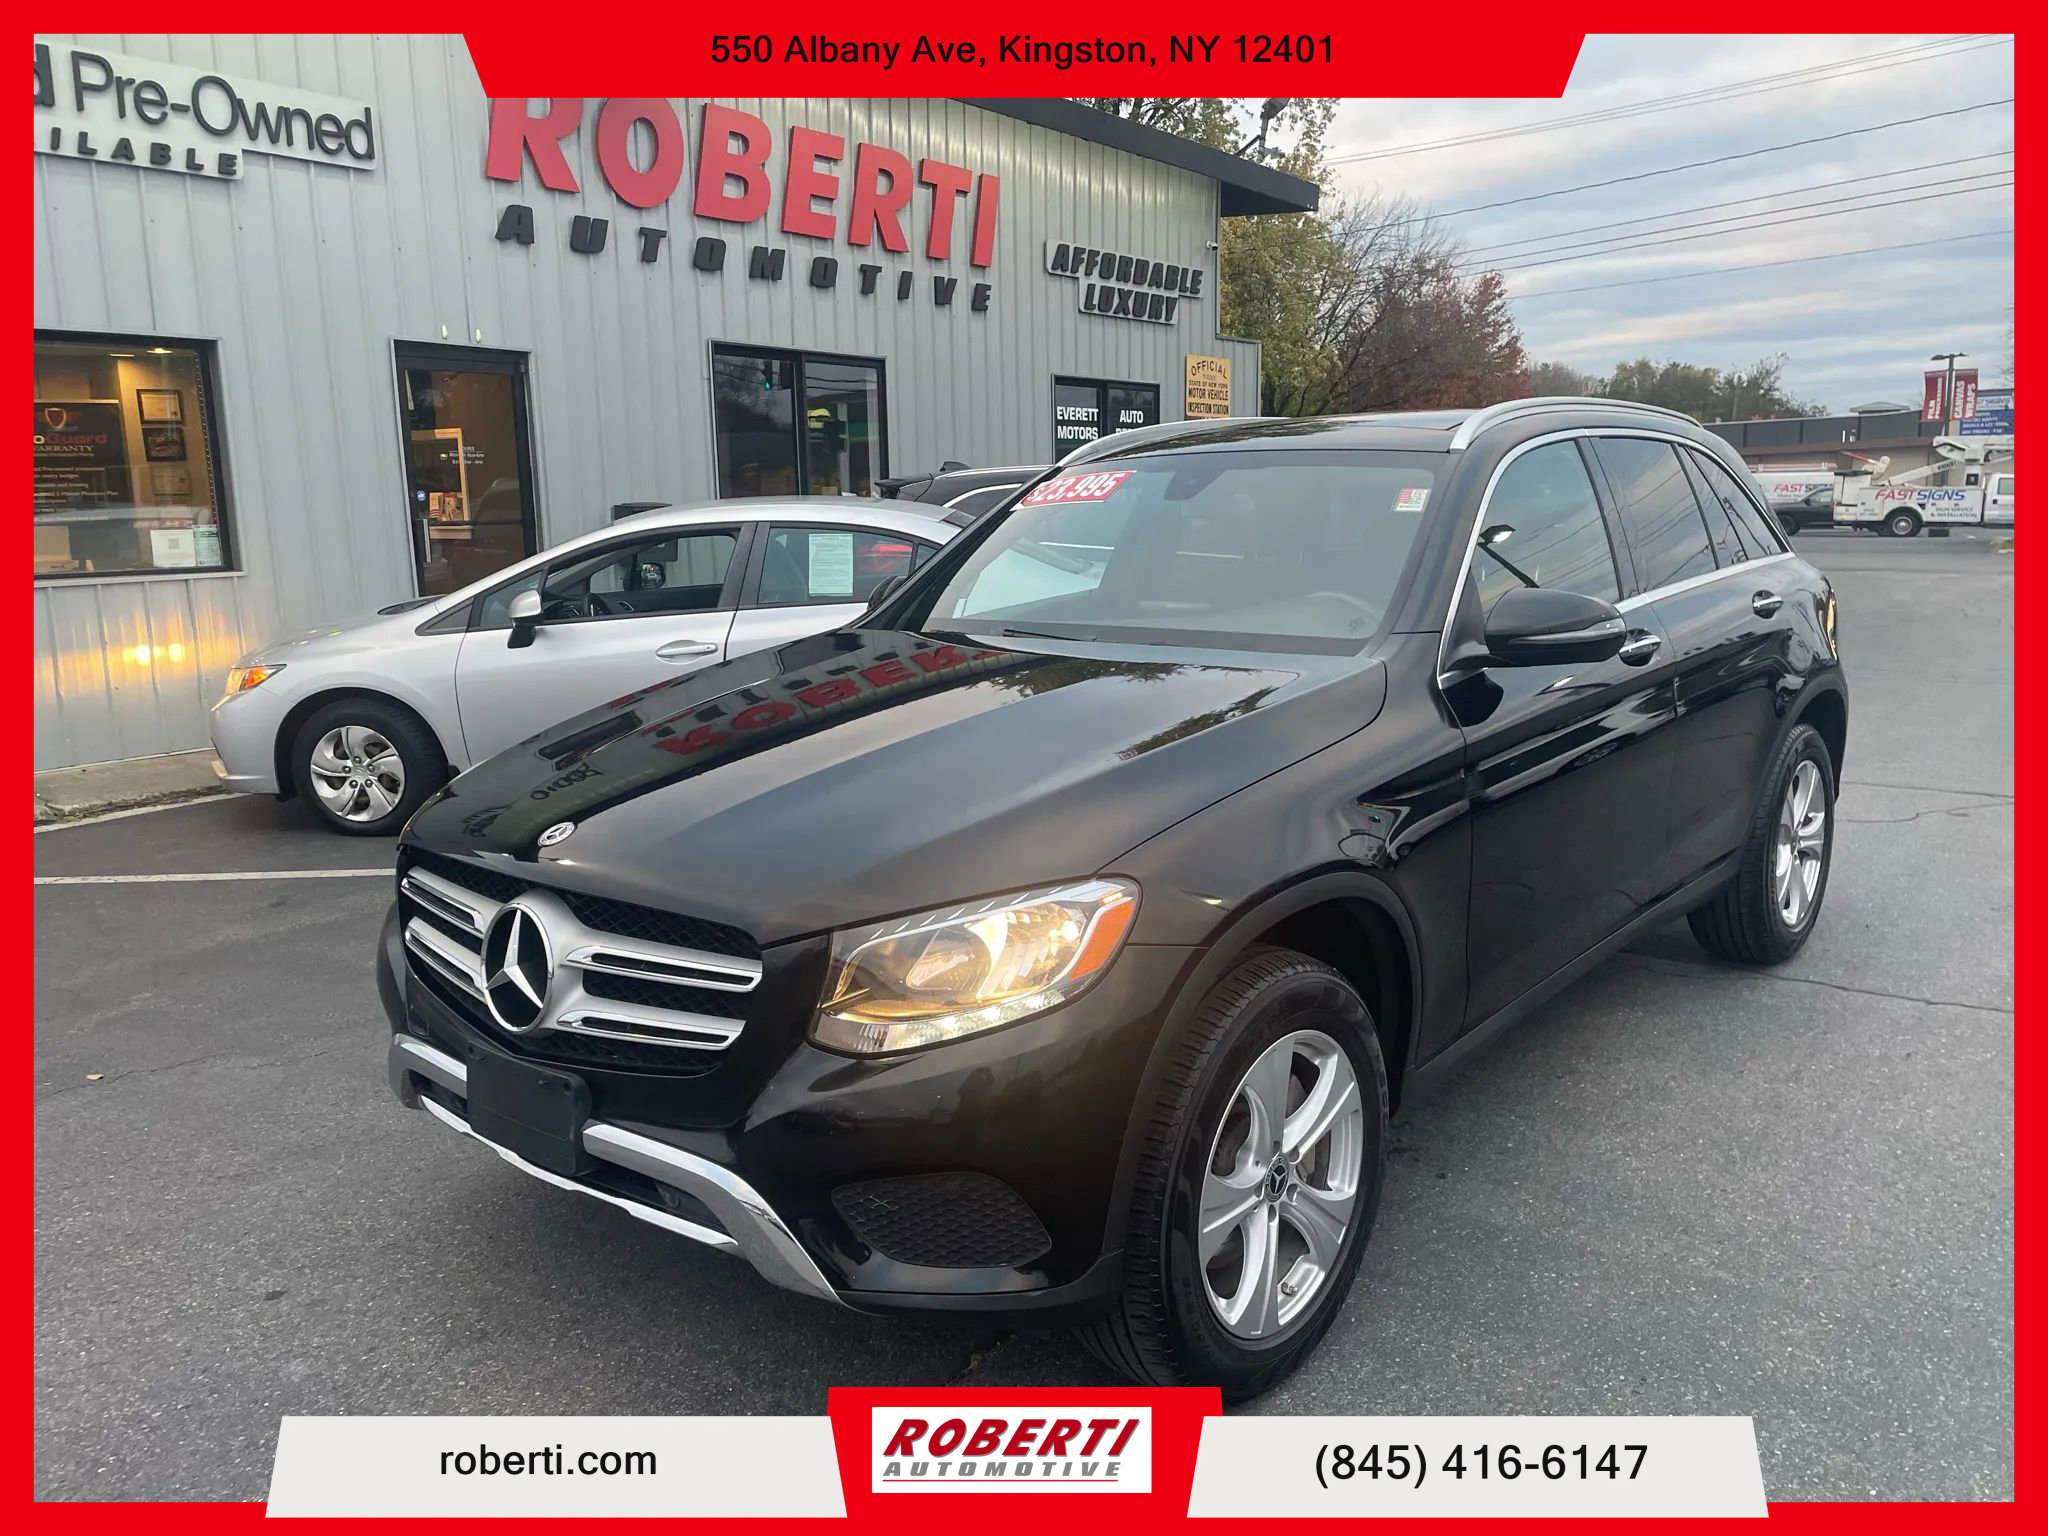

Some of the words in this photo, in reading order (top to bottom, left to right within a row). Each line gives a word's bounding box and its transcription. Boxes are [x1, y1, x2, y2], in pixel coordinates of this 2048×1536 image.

[71, 50, 376, 160] Pre-Owned
[486, 97, 1000, 267] ROBERTI
[495, 204, 993, 311] AUTOMOTIVE
[1051, 243, 1203, 294] AFFORDABLE
[1083, 283, 1179, 321] LUXURY
[1190, 360, 1228, 380] OFFICIAL
[1188, 387, 1206, 399] MOTOR
[1207, 389, 1229, 401] VEHICLE
[1188, 401, 1212, 414] INSPECTION
[1212, 403, 1229, 415] STATION
[1954, 380, 1965, 419] CANVAS
[1964, 382, 1977, 419] WRAPS
[1056, 406, 1099, 422] EVERETT
[1119, 409, 1144, 424] AUTO
[1057, 426, 1099, 440] MOTORS
